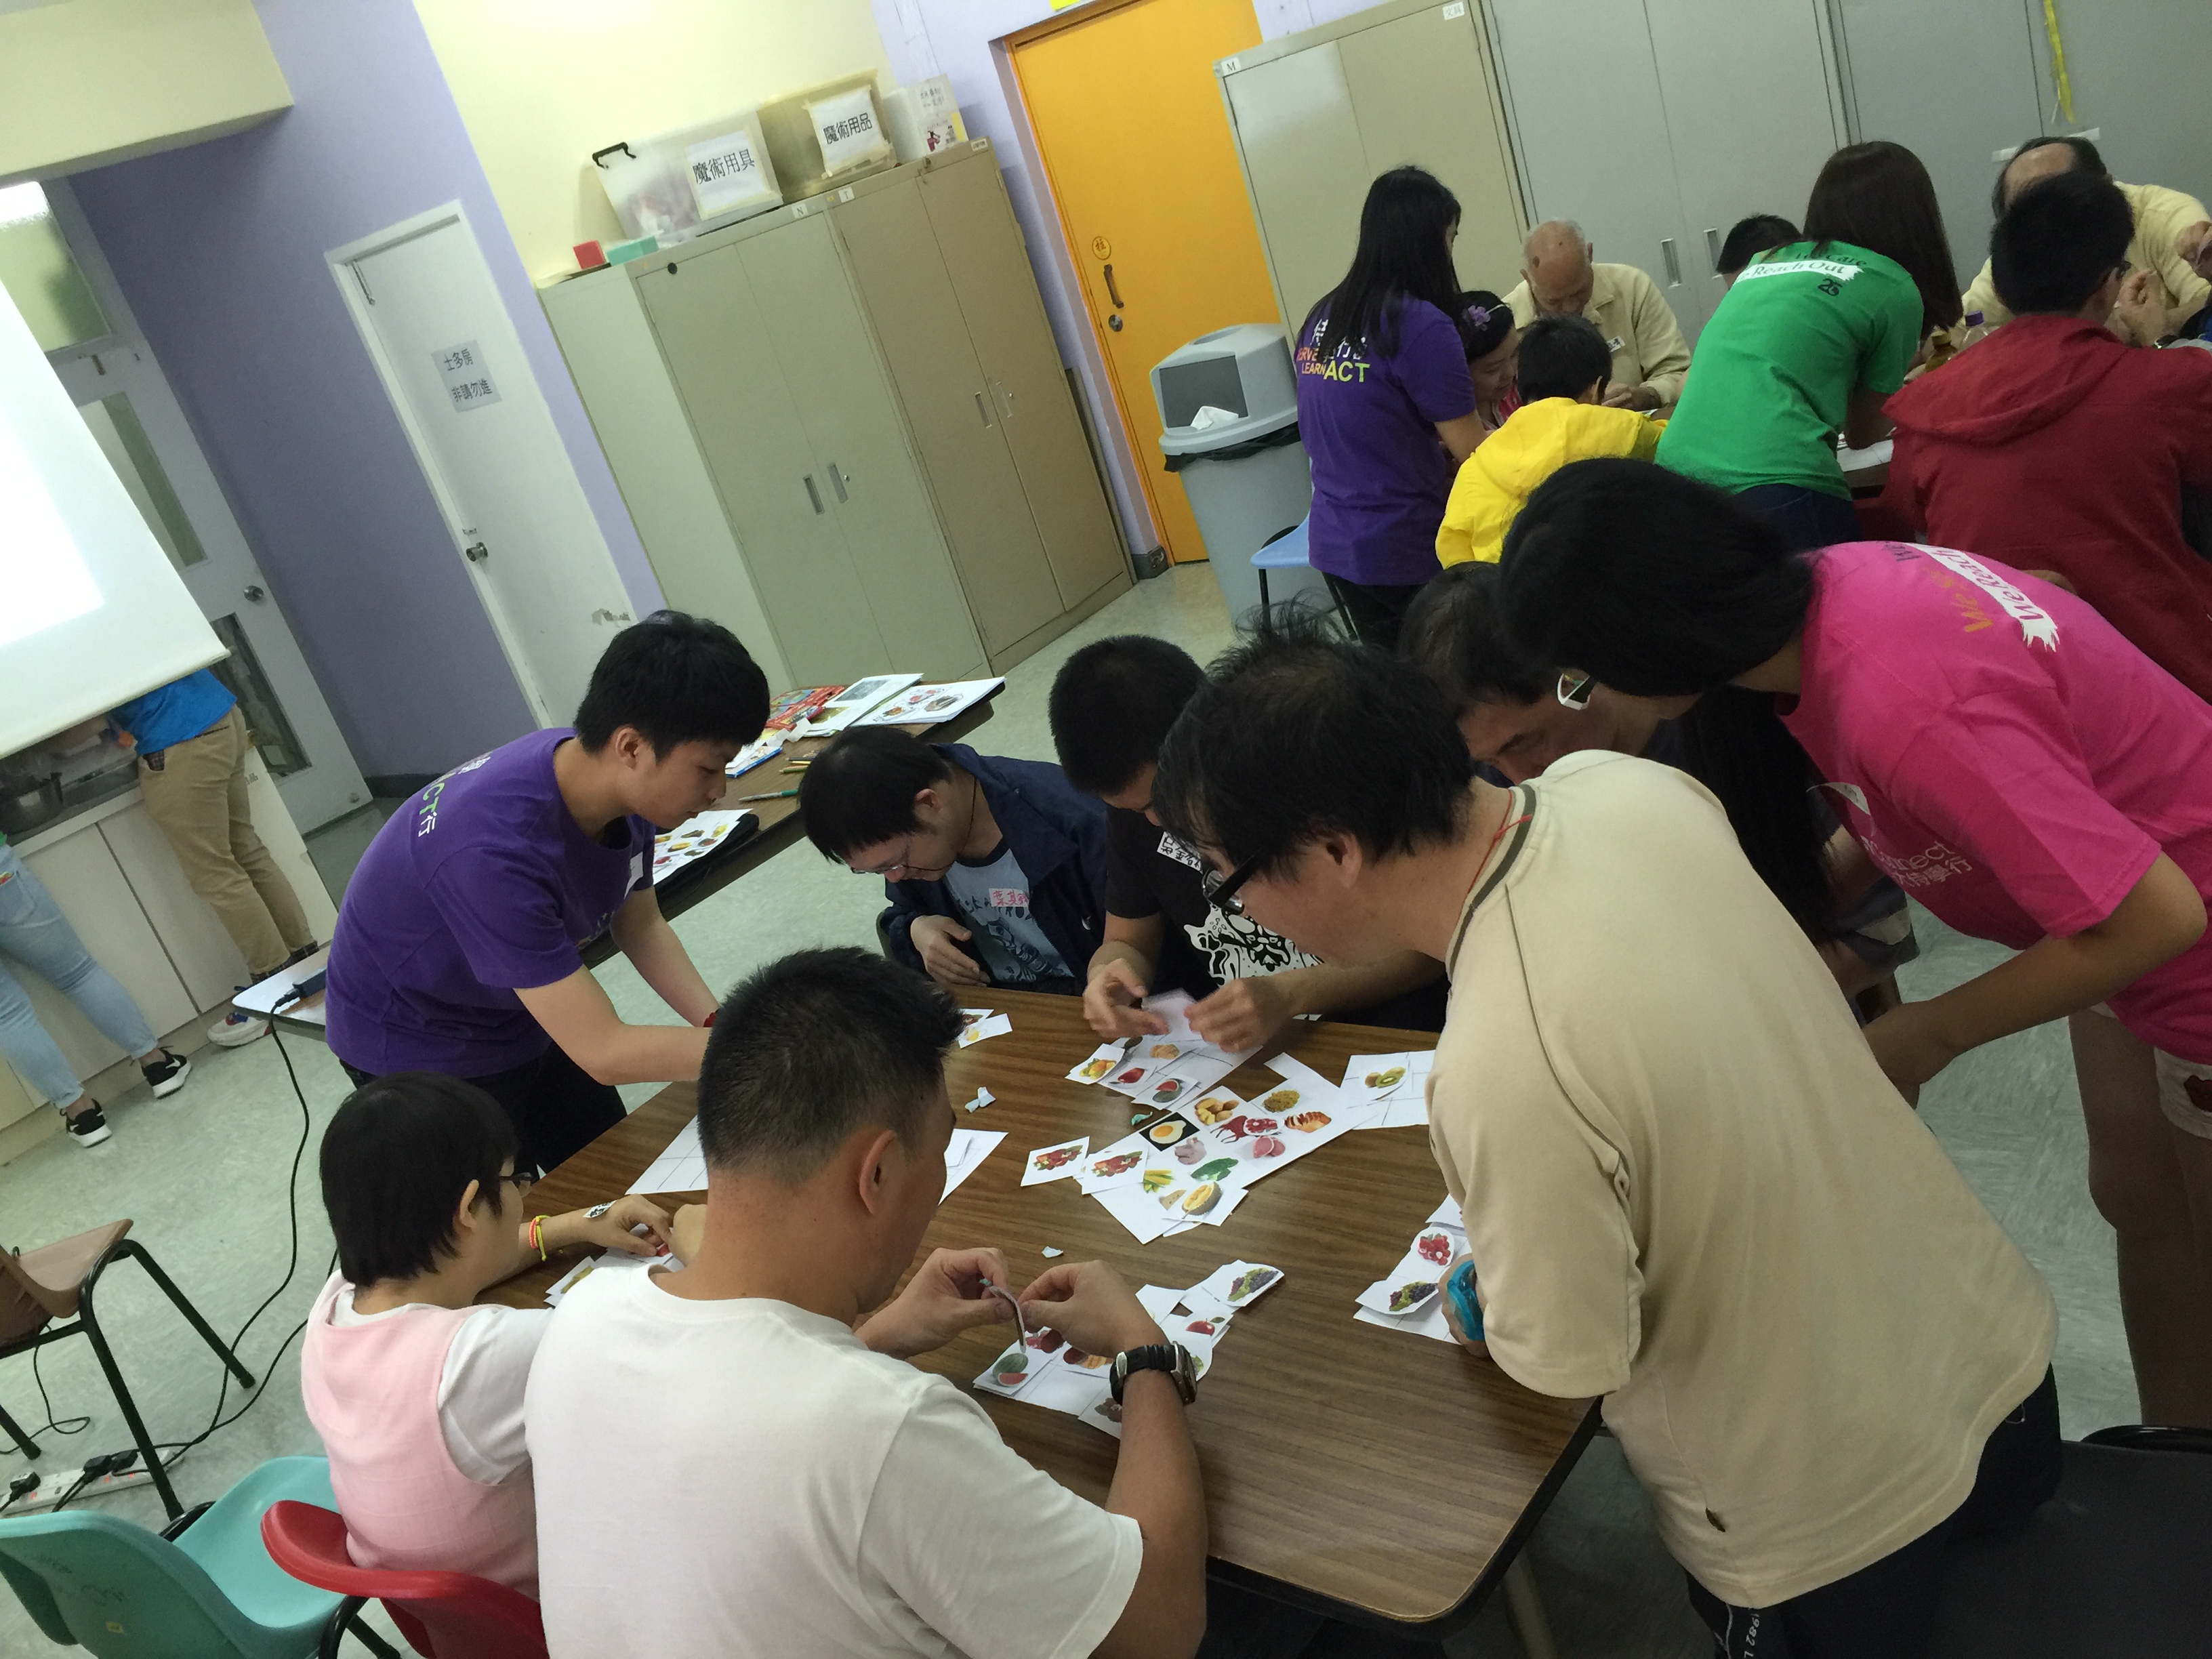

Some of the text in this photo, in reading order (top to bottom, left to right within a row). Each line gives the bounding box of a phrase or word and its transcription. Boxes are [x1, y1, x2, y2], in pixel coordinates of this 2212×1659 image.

[1227, 62, 1236, 73] M
[823, 112, 872, 144] 魔術用品
[692, 148, 755, 185] 魔術用具
[1808, 262, 1845, 274] Out
[444, 348, 473, 371] 士多房
[1302, 362, 1326, 375] LEARN
[1324, 360, 1370, 383] ACT
[451, 378, 492, 402] 非請勿進
[1932, 550, 2009, 589] Reach
[2003, 591, 2044, 619] We
